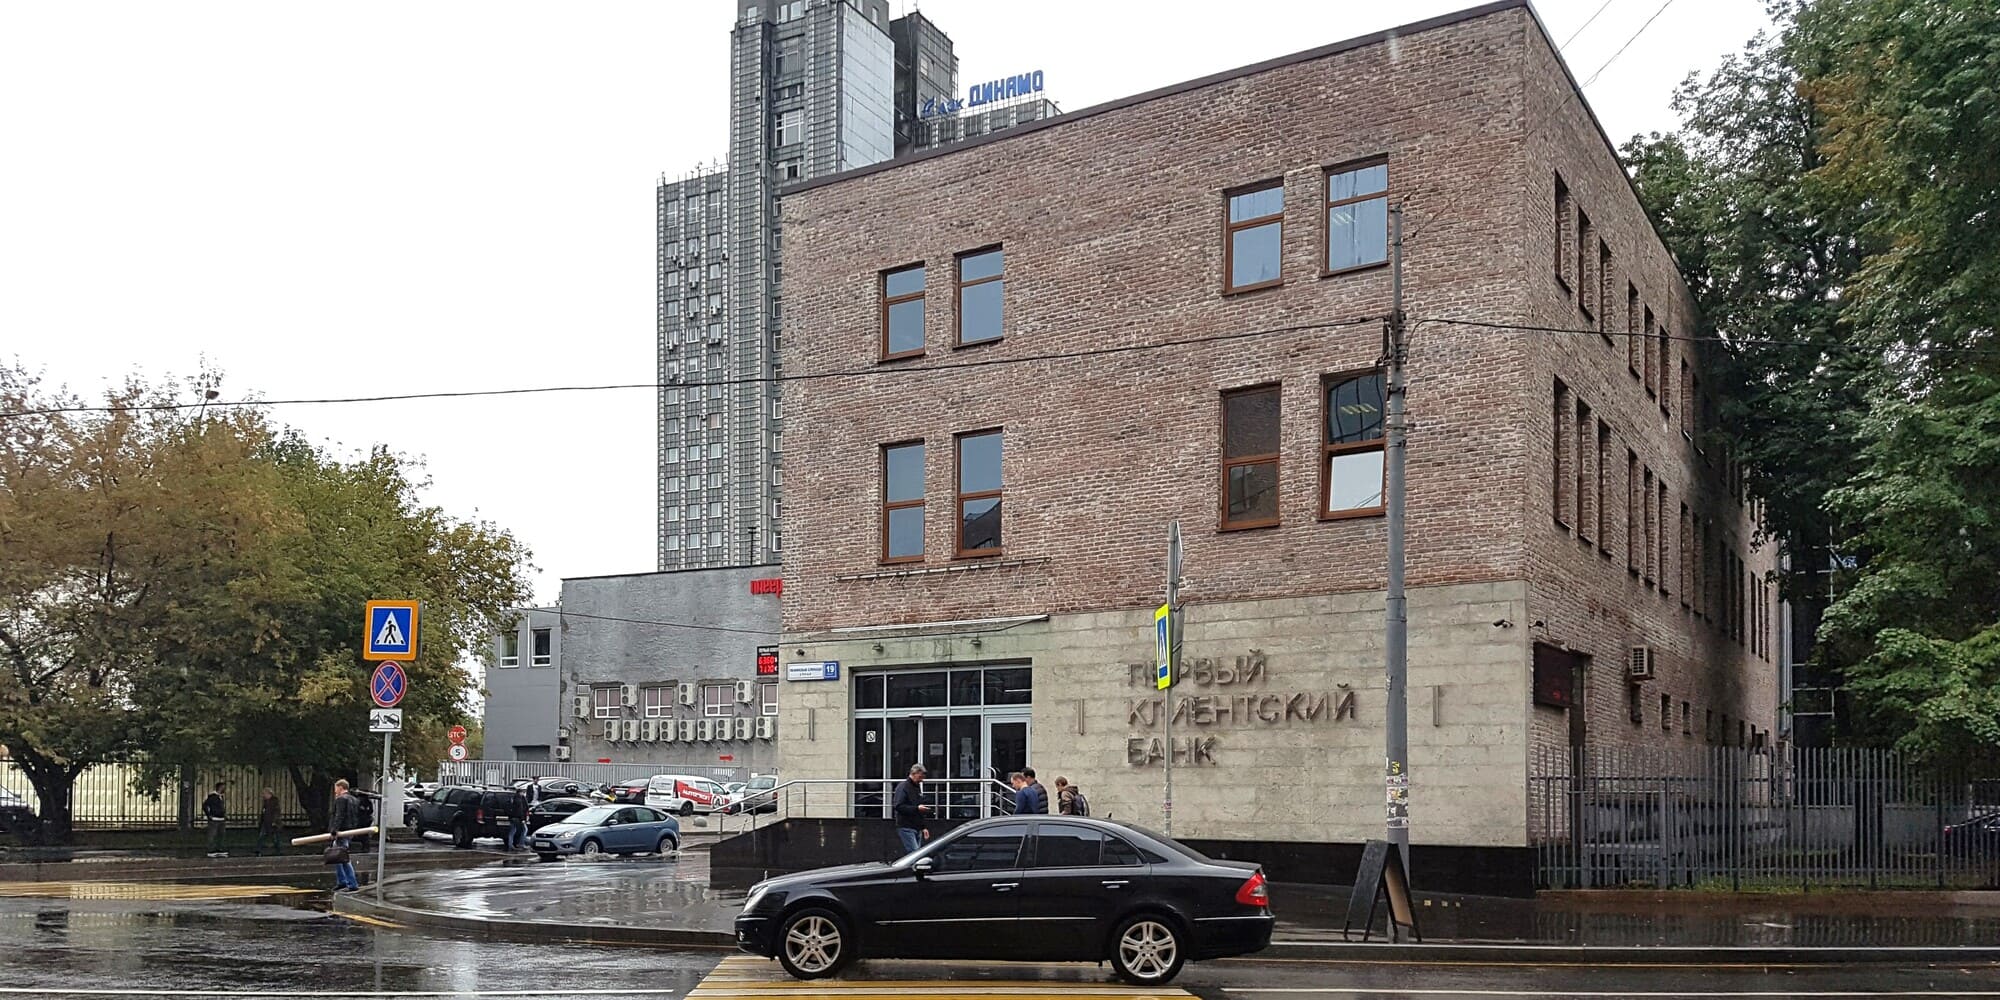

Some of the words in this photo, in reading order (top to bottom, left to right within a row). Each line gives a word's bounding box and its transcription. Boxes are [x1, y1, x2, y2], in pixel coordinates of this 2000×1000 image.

[968, 69, 1044, 107] ДИНАМО
[826, 664, 835, 673] 19
[1127, 683, 1355, 726] КЛИЕНТСКИЙ
[455, 748, 461, 757] 5
[1127, 736, 1217, 766] БАНК
